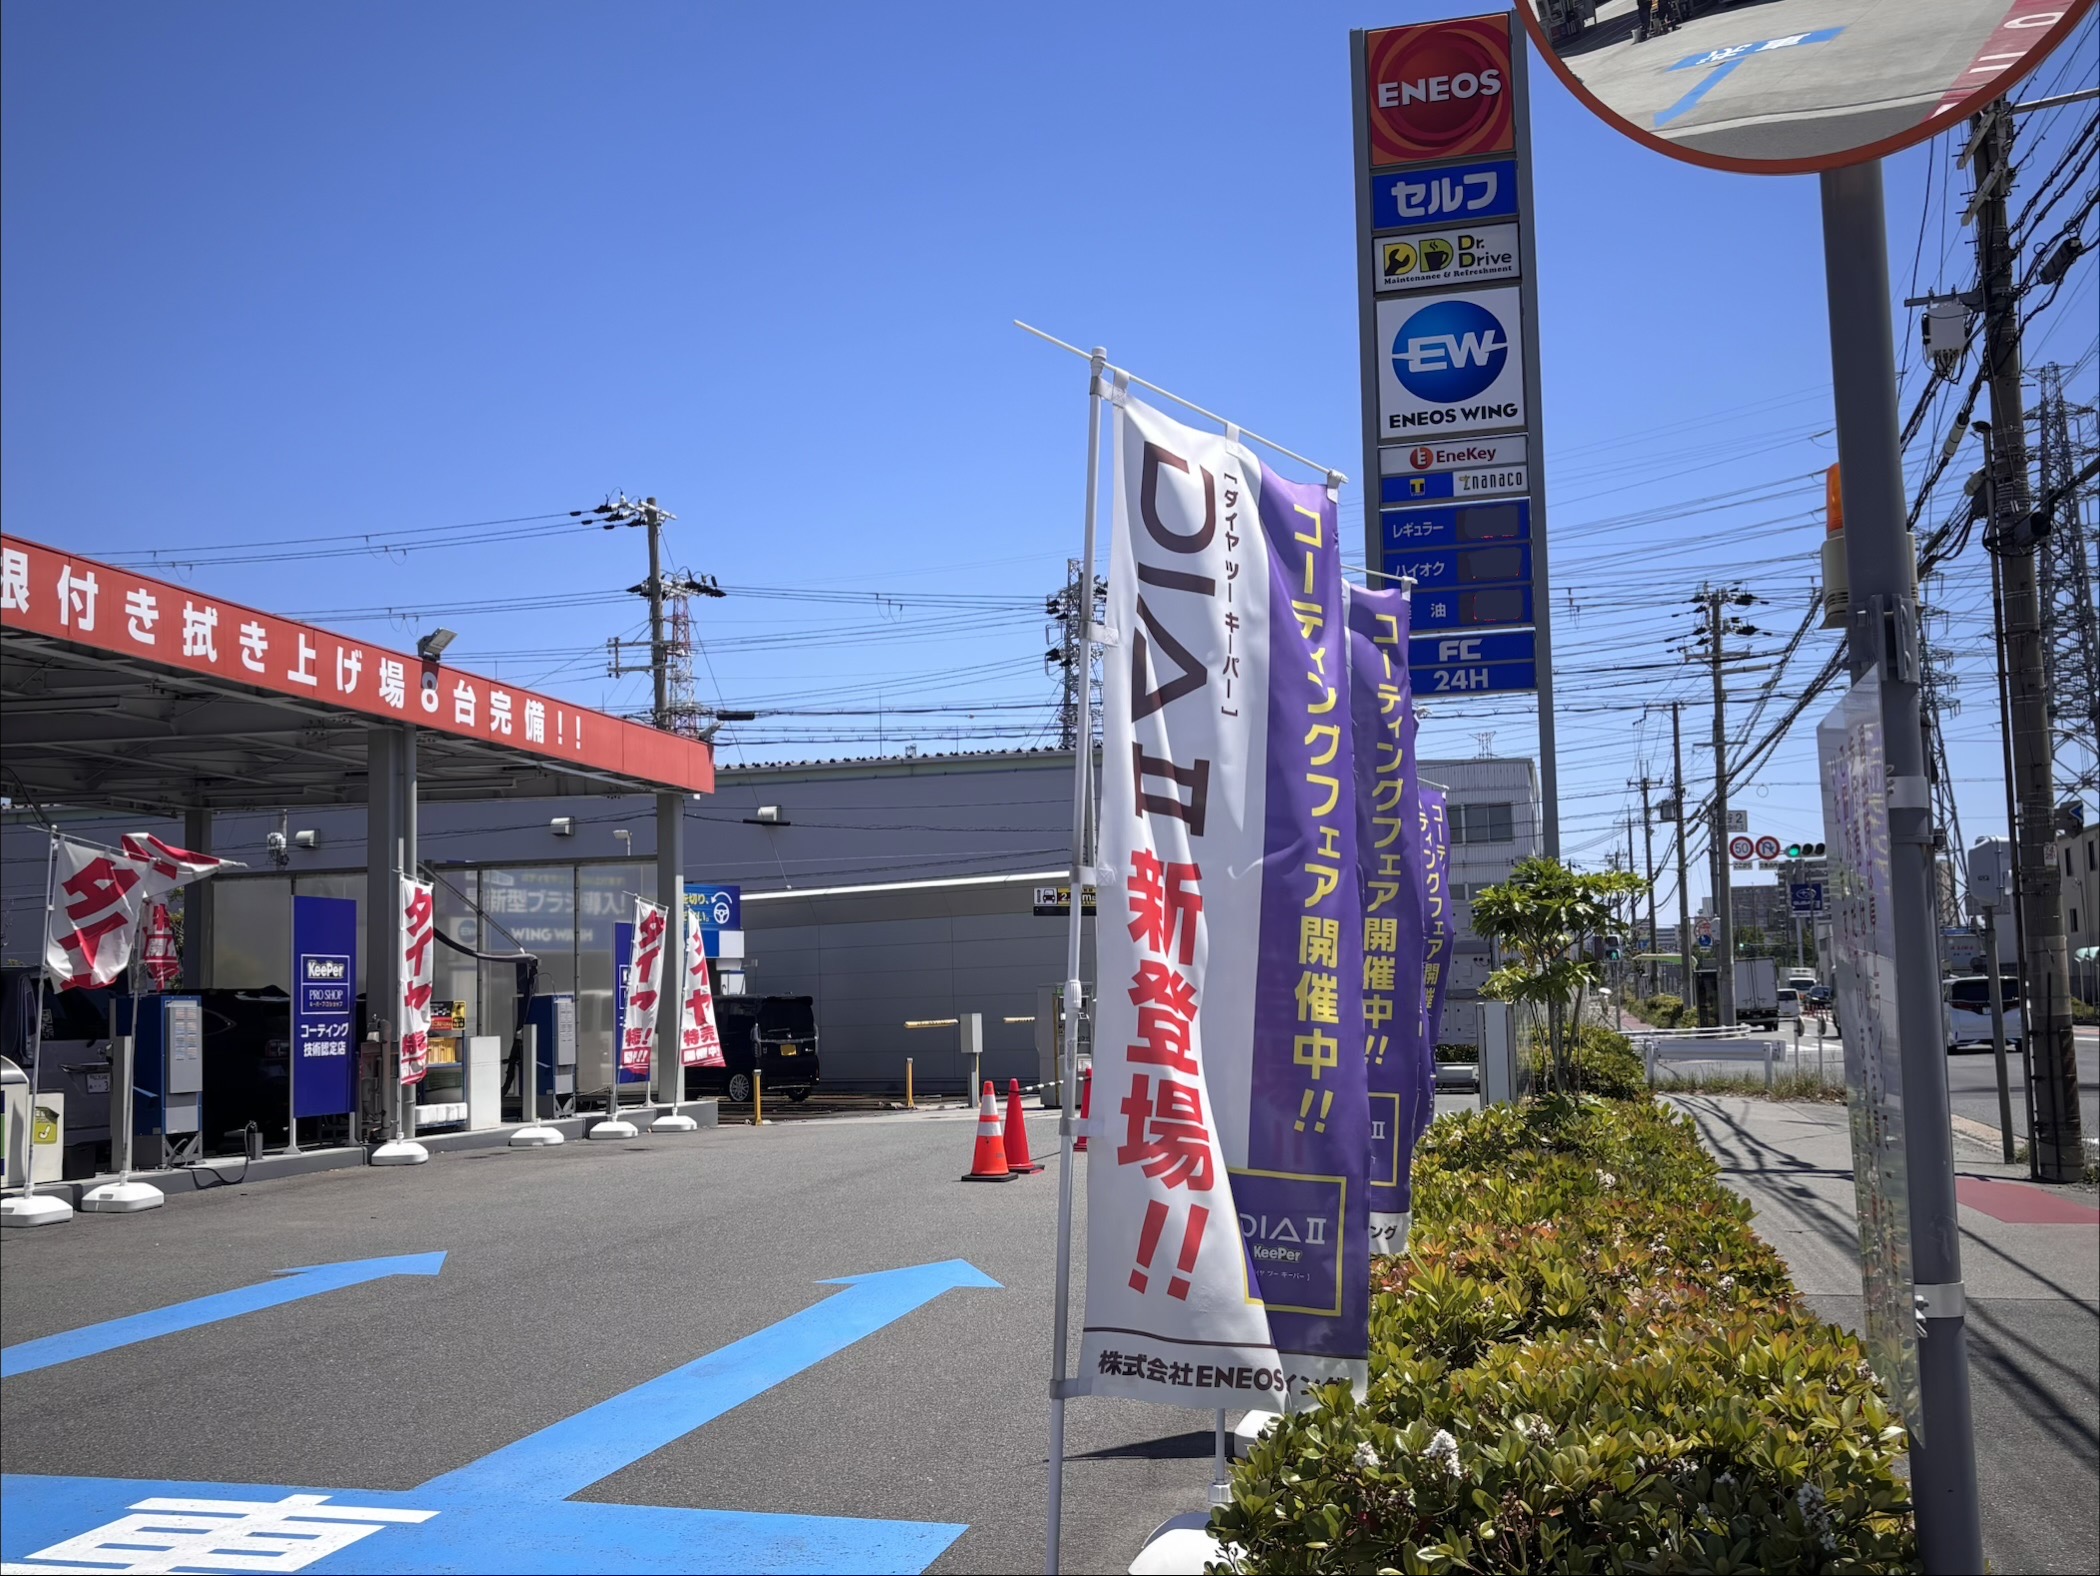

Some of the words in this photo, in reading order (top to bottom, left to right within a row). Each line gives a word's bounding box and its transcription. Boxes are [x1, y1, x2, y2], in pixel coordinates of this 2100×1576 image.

[1377, 69, 1501, 108] ENEOS
[1391, 172, 1498, 217] セルフ
[1458, 235, 1485, 251] Dr.
[1458, 252, 1512, 268] Drive
[1384, 274, 1441, 285] Maintenance
[1453, 265, 1512, 278] Refreshment
[1408, 329, 1496, 373] EW
[1389, 407, 1457, 429] ENEOS
[1460, 402, 1518, 421] WING
[1436, 447, 1496, 463] EneKey
[1472, 471, 1523, 489] nanaco
[1393, 522, 1444, 538] レギュラー
[1396, 561, 1445, 577] ハイオク
[1438, 638, 1483, 661] FC
[1433, 668, 1489, 691] 24H
[1735, 842, 1750, 854] 50
[511, 927, 552, 941] WING
[307, 960, 344, 979] KeePer
[309, 989, 323, 1000] PRO
[324, 989, 344, 1000] SHOP
[300, 1022, 349, 1038] コーティング
[303, 1041, 346, 1057] 技術認定店
[1117, 847, 1214, 1302] 新登場!!
[1253, 1245, 1301, 1262] KeePer
